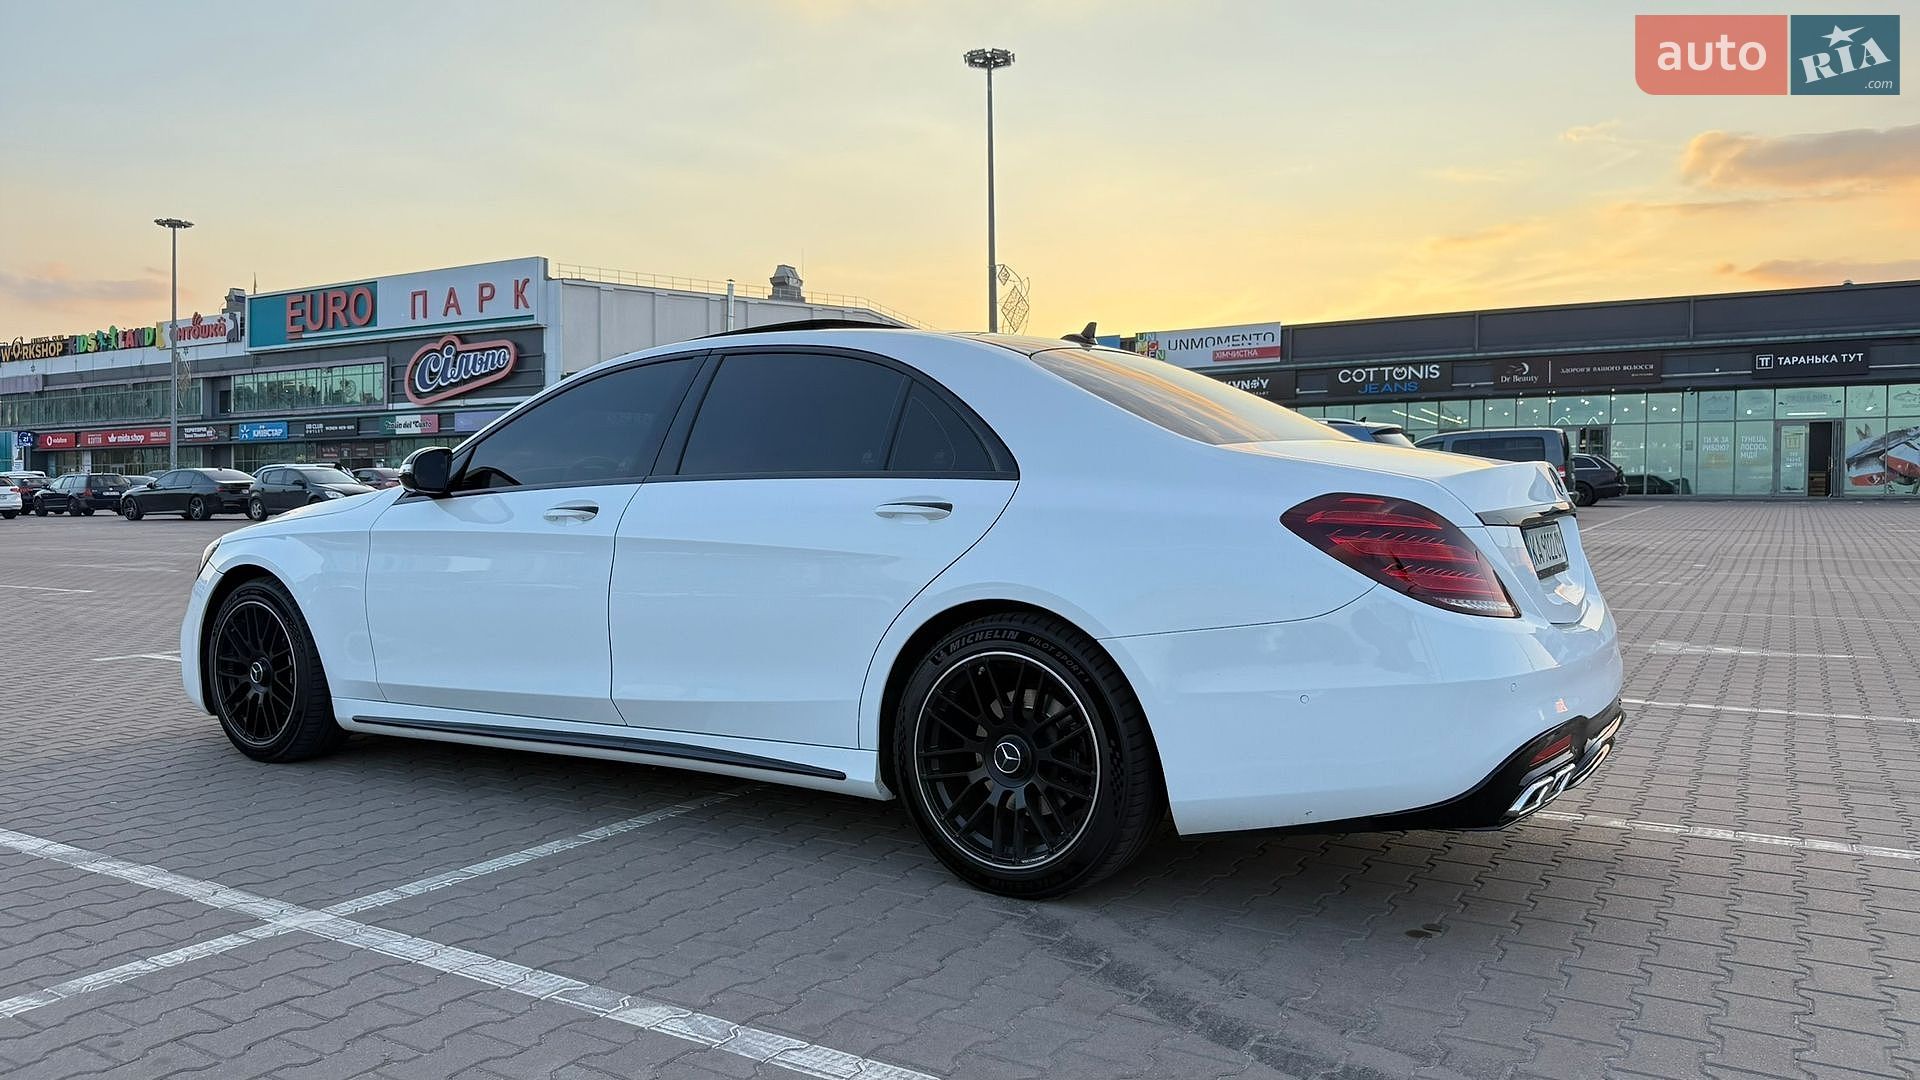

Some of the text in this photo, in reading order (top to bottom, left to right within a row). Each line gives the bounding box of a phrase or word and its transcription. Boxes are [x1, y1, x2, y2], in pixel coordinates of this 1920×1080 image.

[286, 286, 374, 333] EURO
[175, 321, 227, 341] НТОШКА
[1168, 332, 1275, 351] UNMOMENTO
[1215, 349, 1258, 359] ХІМЧИСТКА
[1777, 356, 1838, 366] ТАРАНЬКА
[1841, 353, 1864, 363] ТУТ
[415, 344, 510, 393] Сільпо
[1338, 365, 1440, 383] COTTONIS
[1358, 381, 1419, 394] JEANS
[1501, 374, 1539, 383] Dr Beauty
[950, 629, 1085, 676] MICHELIN PILOT SPORT
